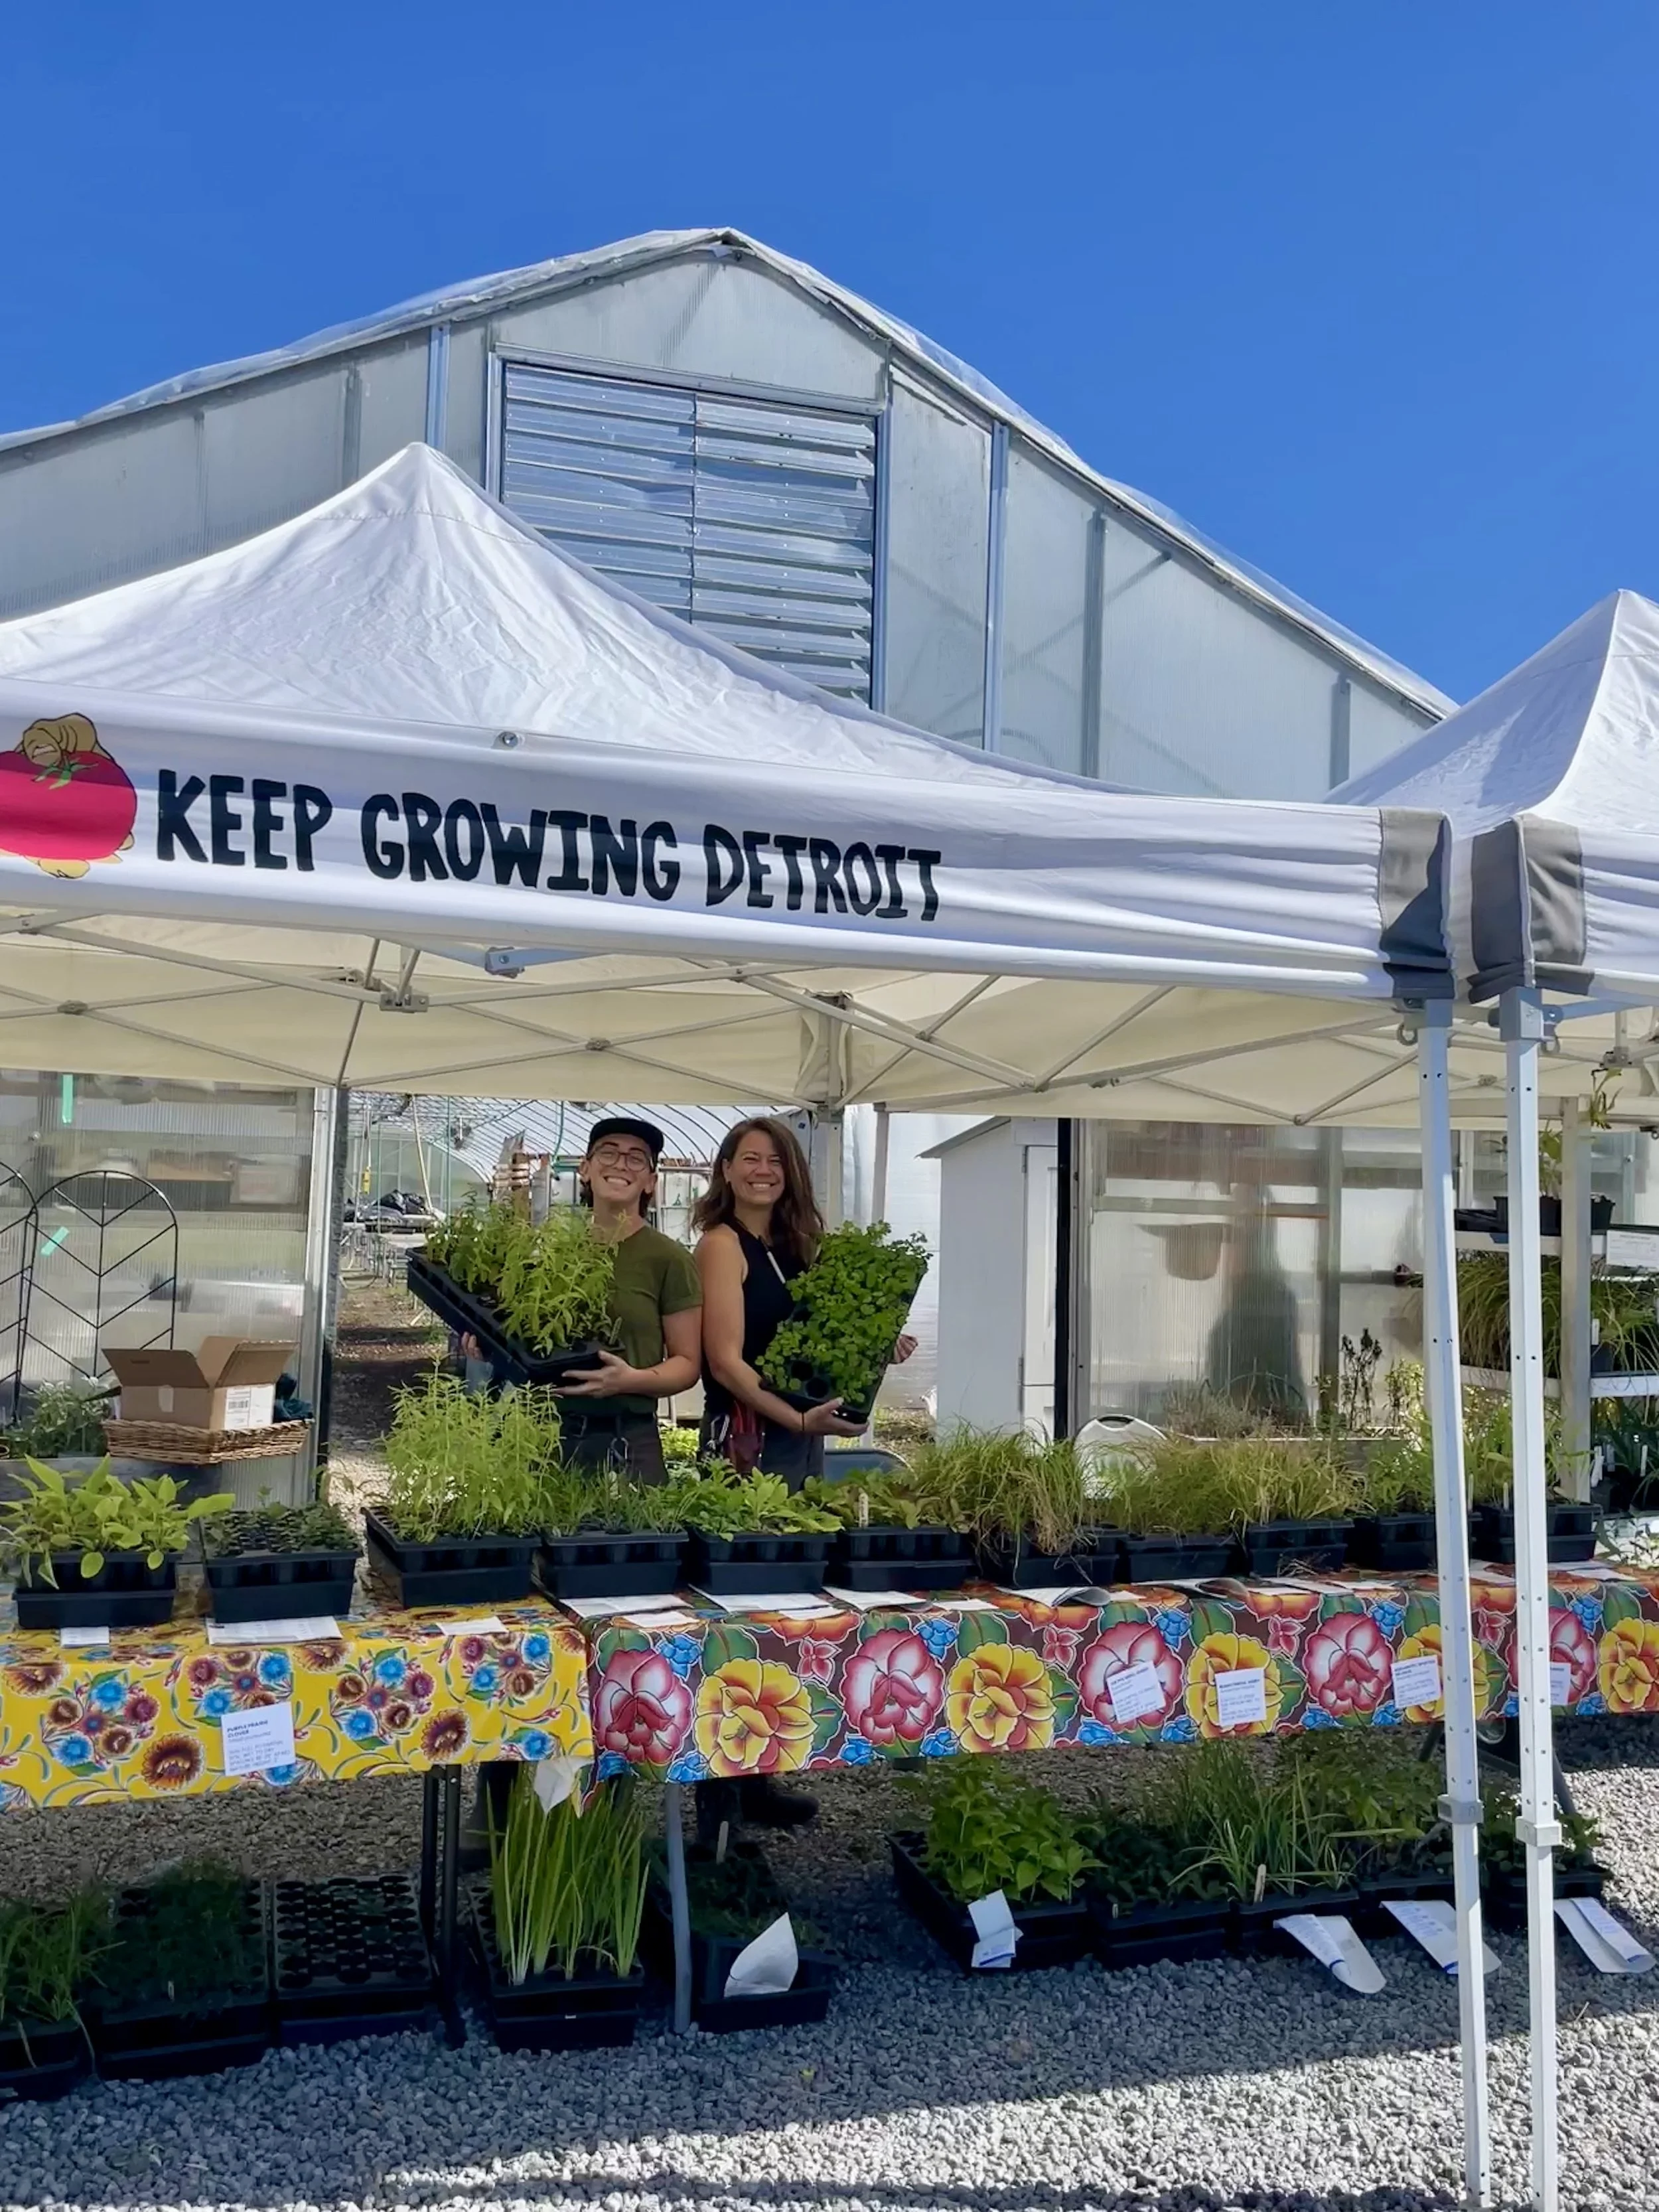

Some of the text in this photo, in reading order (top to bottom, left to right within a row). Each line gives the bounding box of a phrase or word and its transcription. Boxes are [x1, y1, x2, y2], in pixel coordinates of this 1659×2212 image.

[157, 769, 942, 922] KEEP GROWING DETROIT
